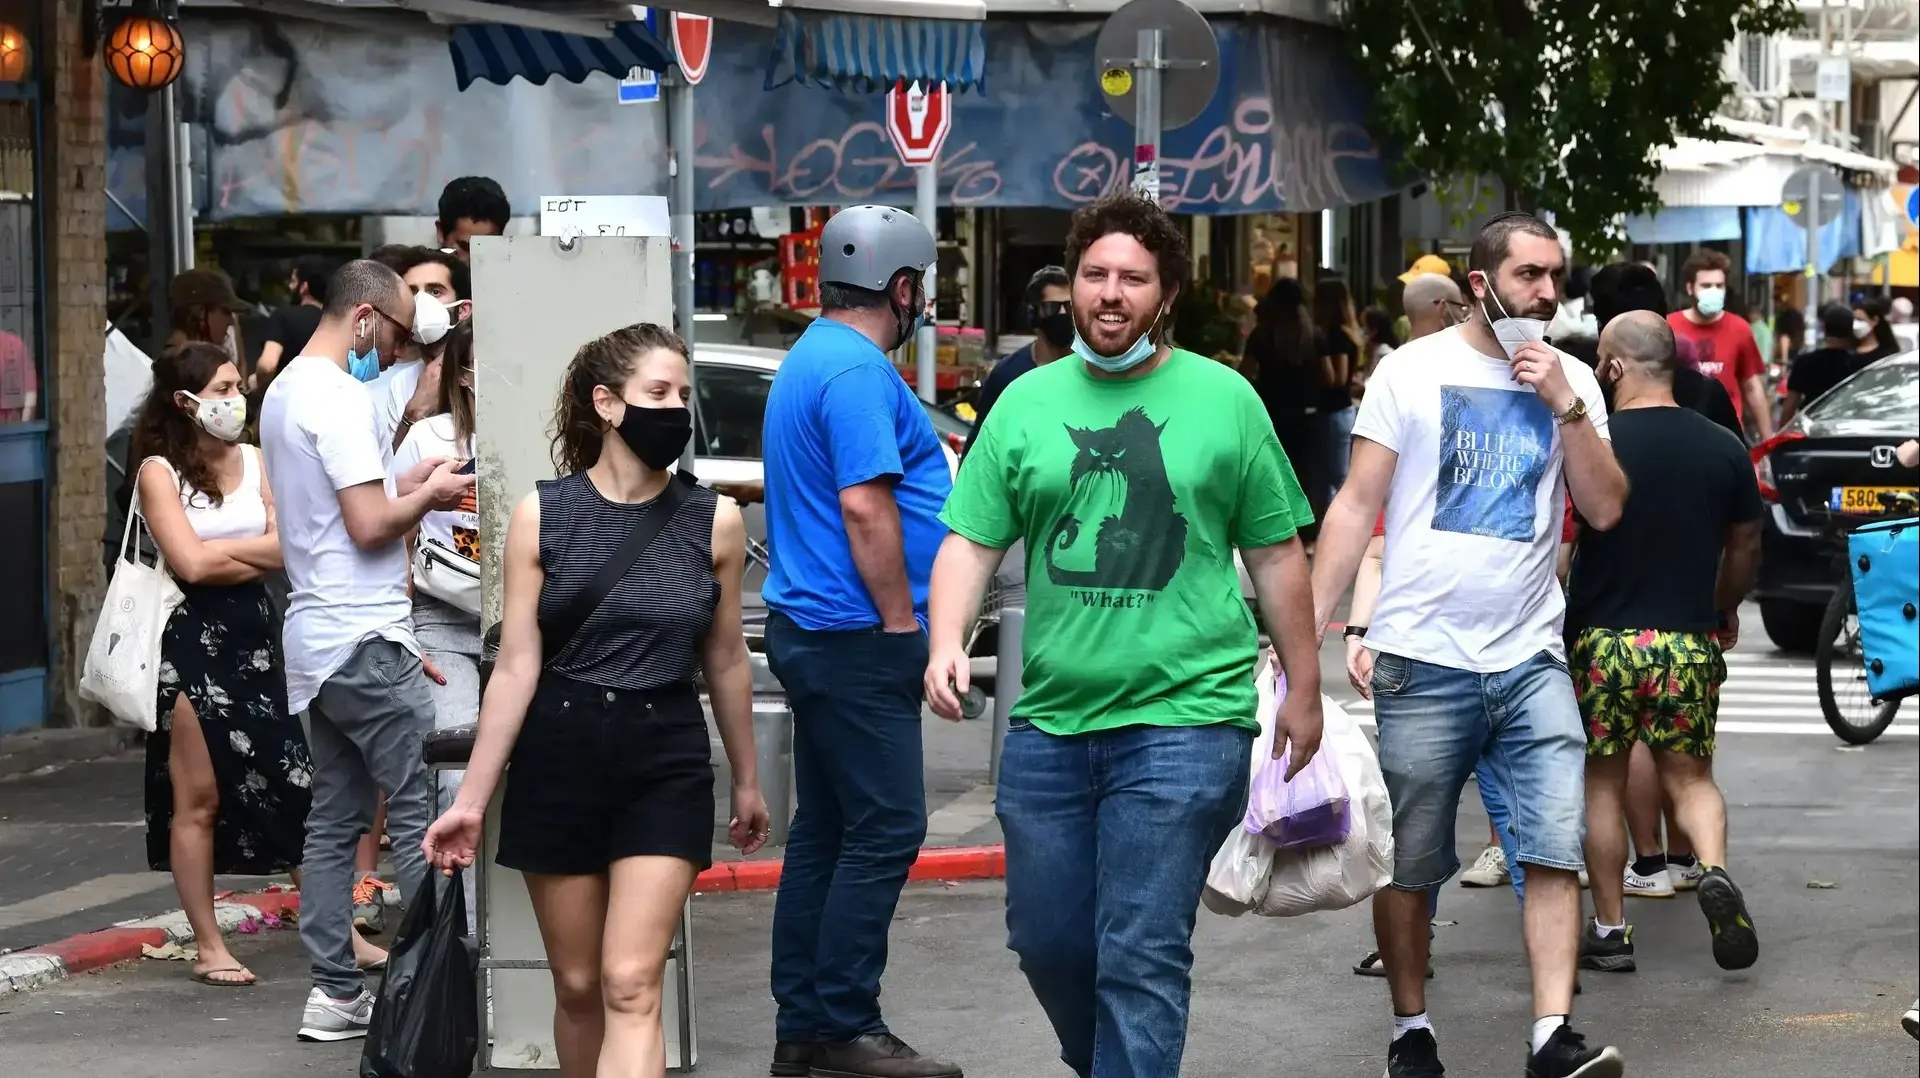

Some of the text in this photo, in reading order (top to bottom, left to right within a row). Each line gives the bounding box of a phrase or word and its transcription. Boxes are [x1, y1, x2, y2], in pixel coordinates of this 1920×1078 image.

[1456, 430, 1512, 454] BLUE
[1456, 450, 1525, 472] WHERE
[1070, 590, 1155, 609] "What?"
